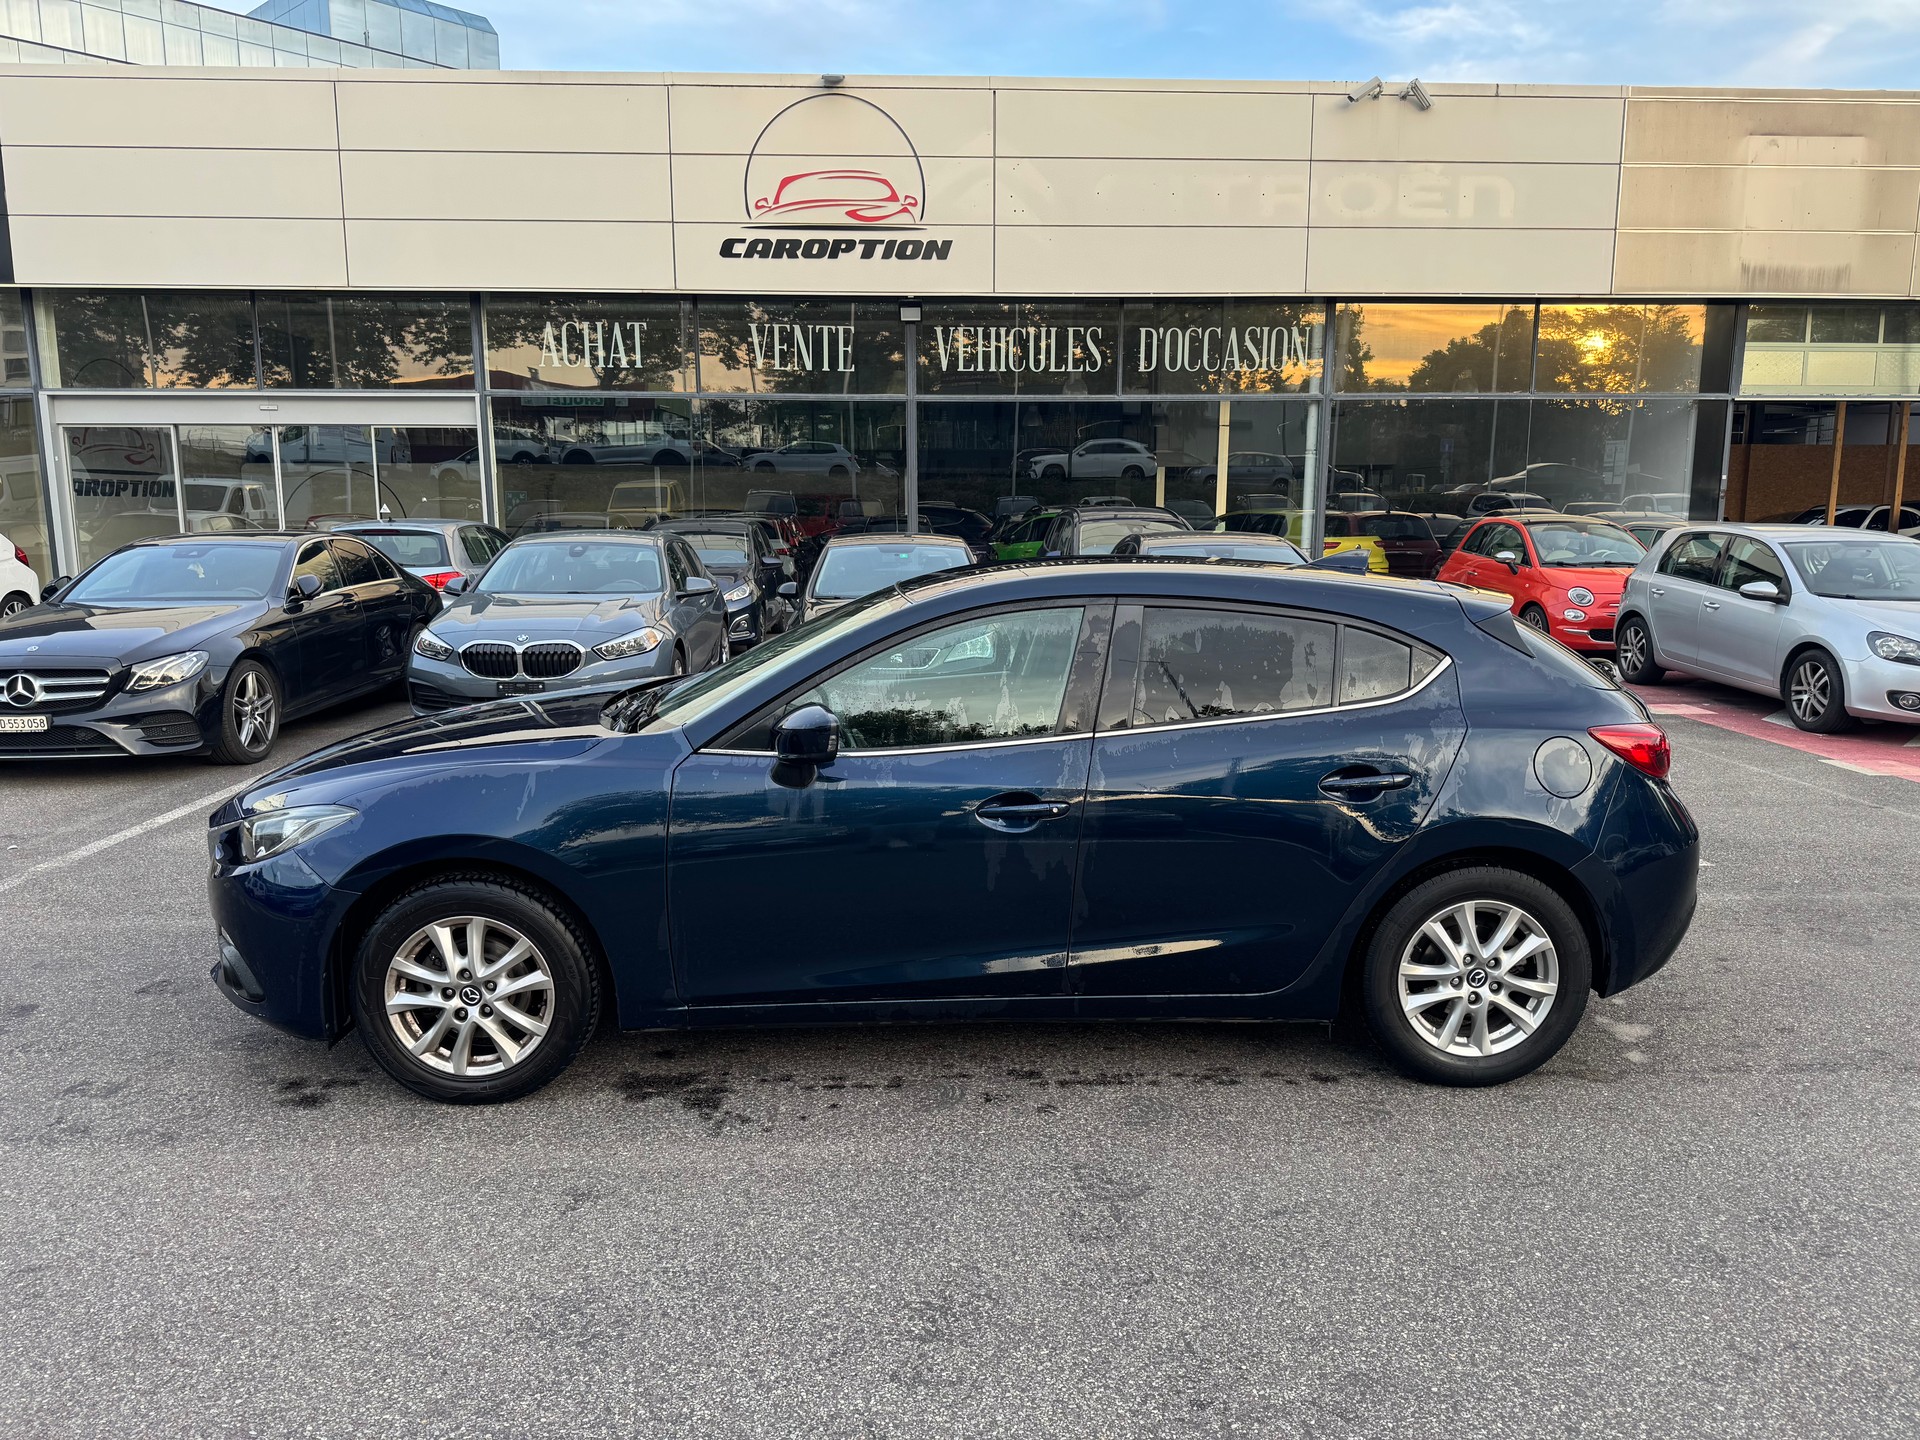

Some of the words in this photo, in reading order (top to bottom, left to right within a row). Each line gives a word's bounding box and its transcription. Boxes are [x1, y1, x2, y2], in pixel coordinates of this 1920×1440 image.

[719, 238, 953, 260] CAROPTION
[539, 321, 647, 369] ACHAT
[749, 323, 855, 372] VENTE
[934, 326, 1102, 373] VEHICULES
[1138, 325, 1311, 373] D'OCCASION
[73, 478, 175, 497] AROPTION
